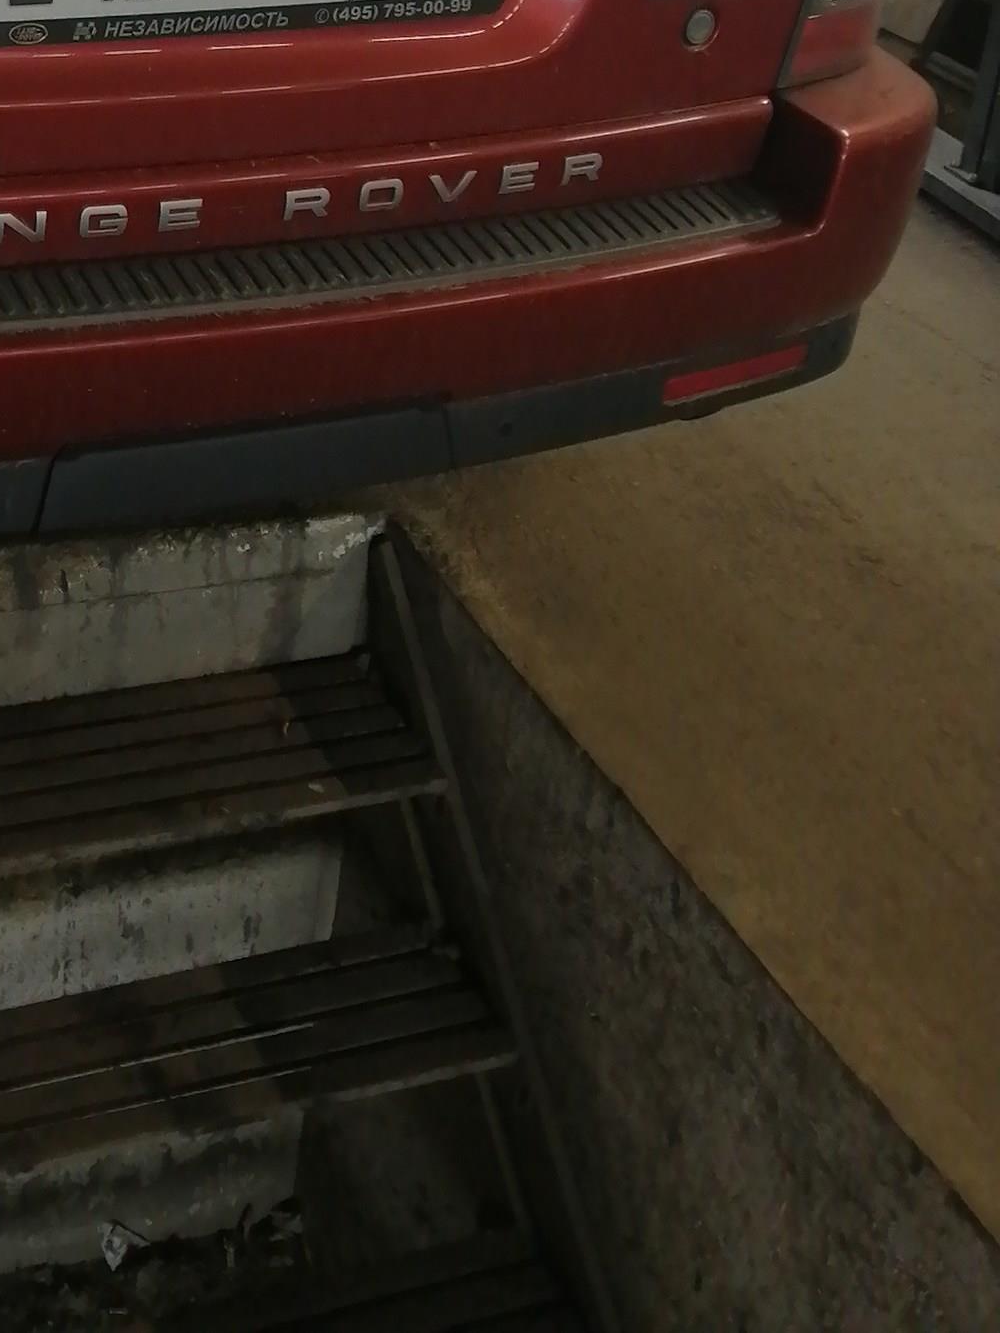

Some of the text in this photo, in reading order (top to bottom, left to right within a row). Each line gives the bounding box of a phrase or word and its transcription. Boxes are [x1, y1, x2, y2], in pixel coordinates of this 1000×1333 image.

[103, 11, 289, 38] НЕЗАВИСИМОСТЬ
[332, 5, 379, 22] (495)
[283, 152, 604, 221] ROVER
